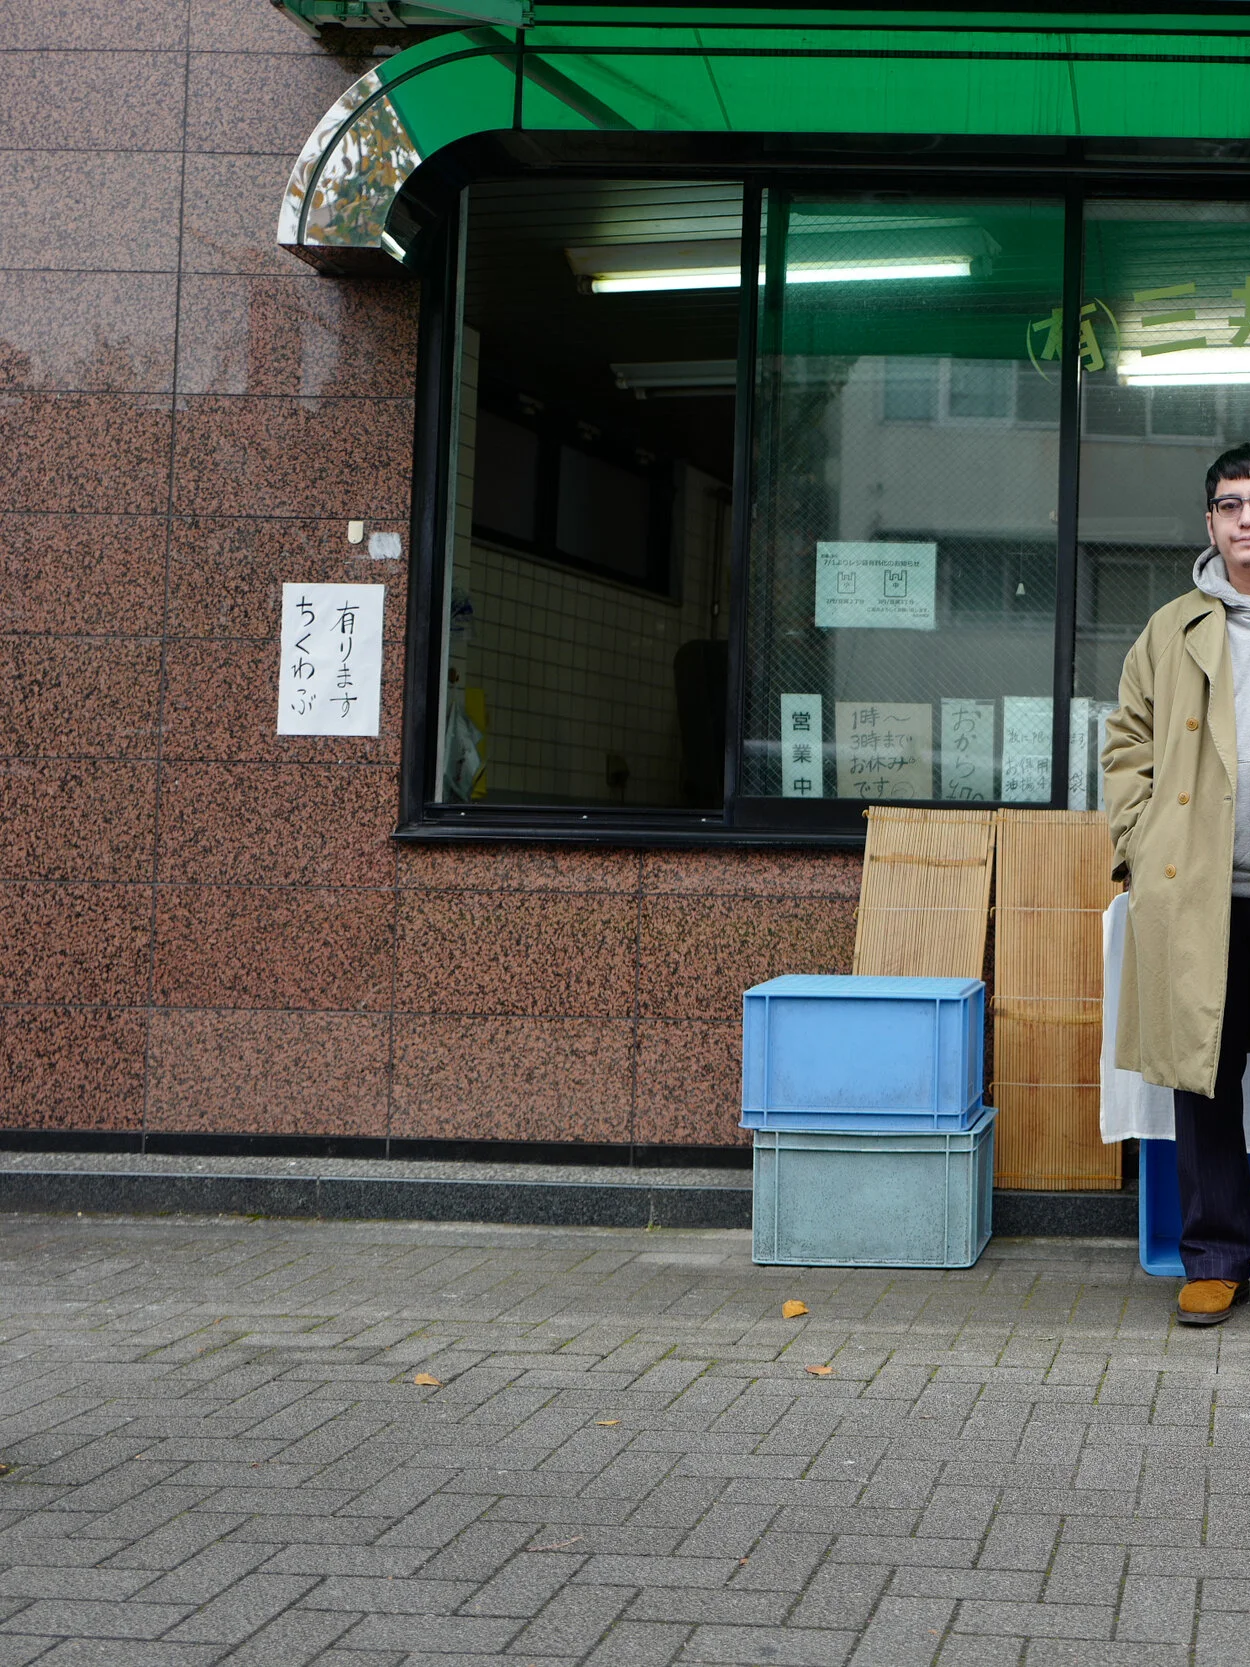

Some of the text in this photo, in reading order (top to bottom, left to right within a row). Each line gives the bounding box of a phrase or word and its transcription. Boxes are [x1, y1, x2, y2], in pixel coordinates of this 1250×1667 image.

[291, 596, 316, 715] ちくわぶ
[330, 600, 360, 718] 有ります
[792, 711, 812, 796] 営業中
